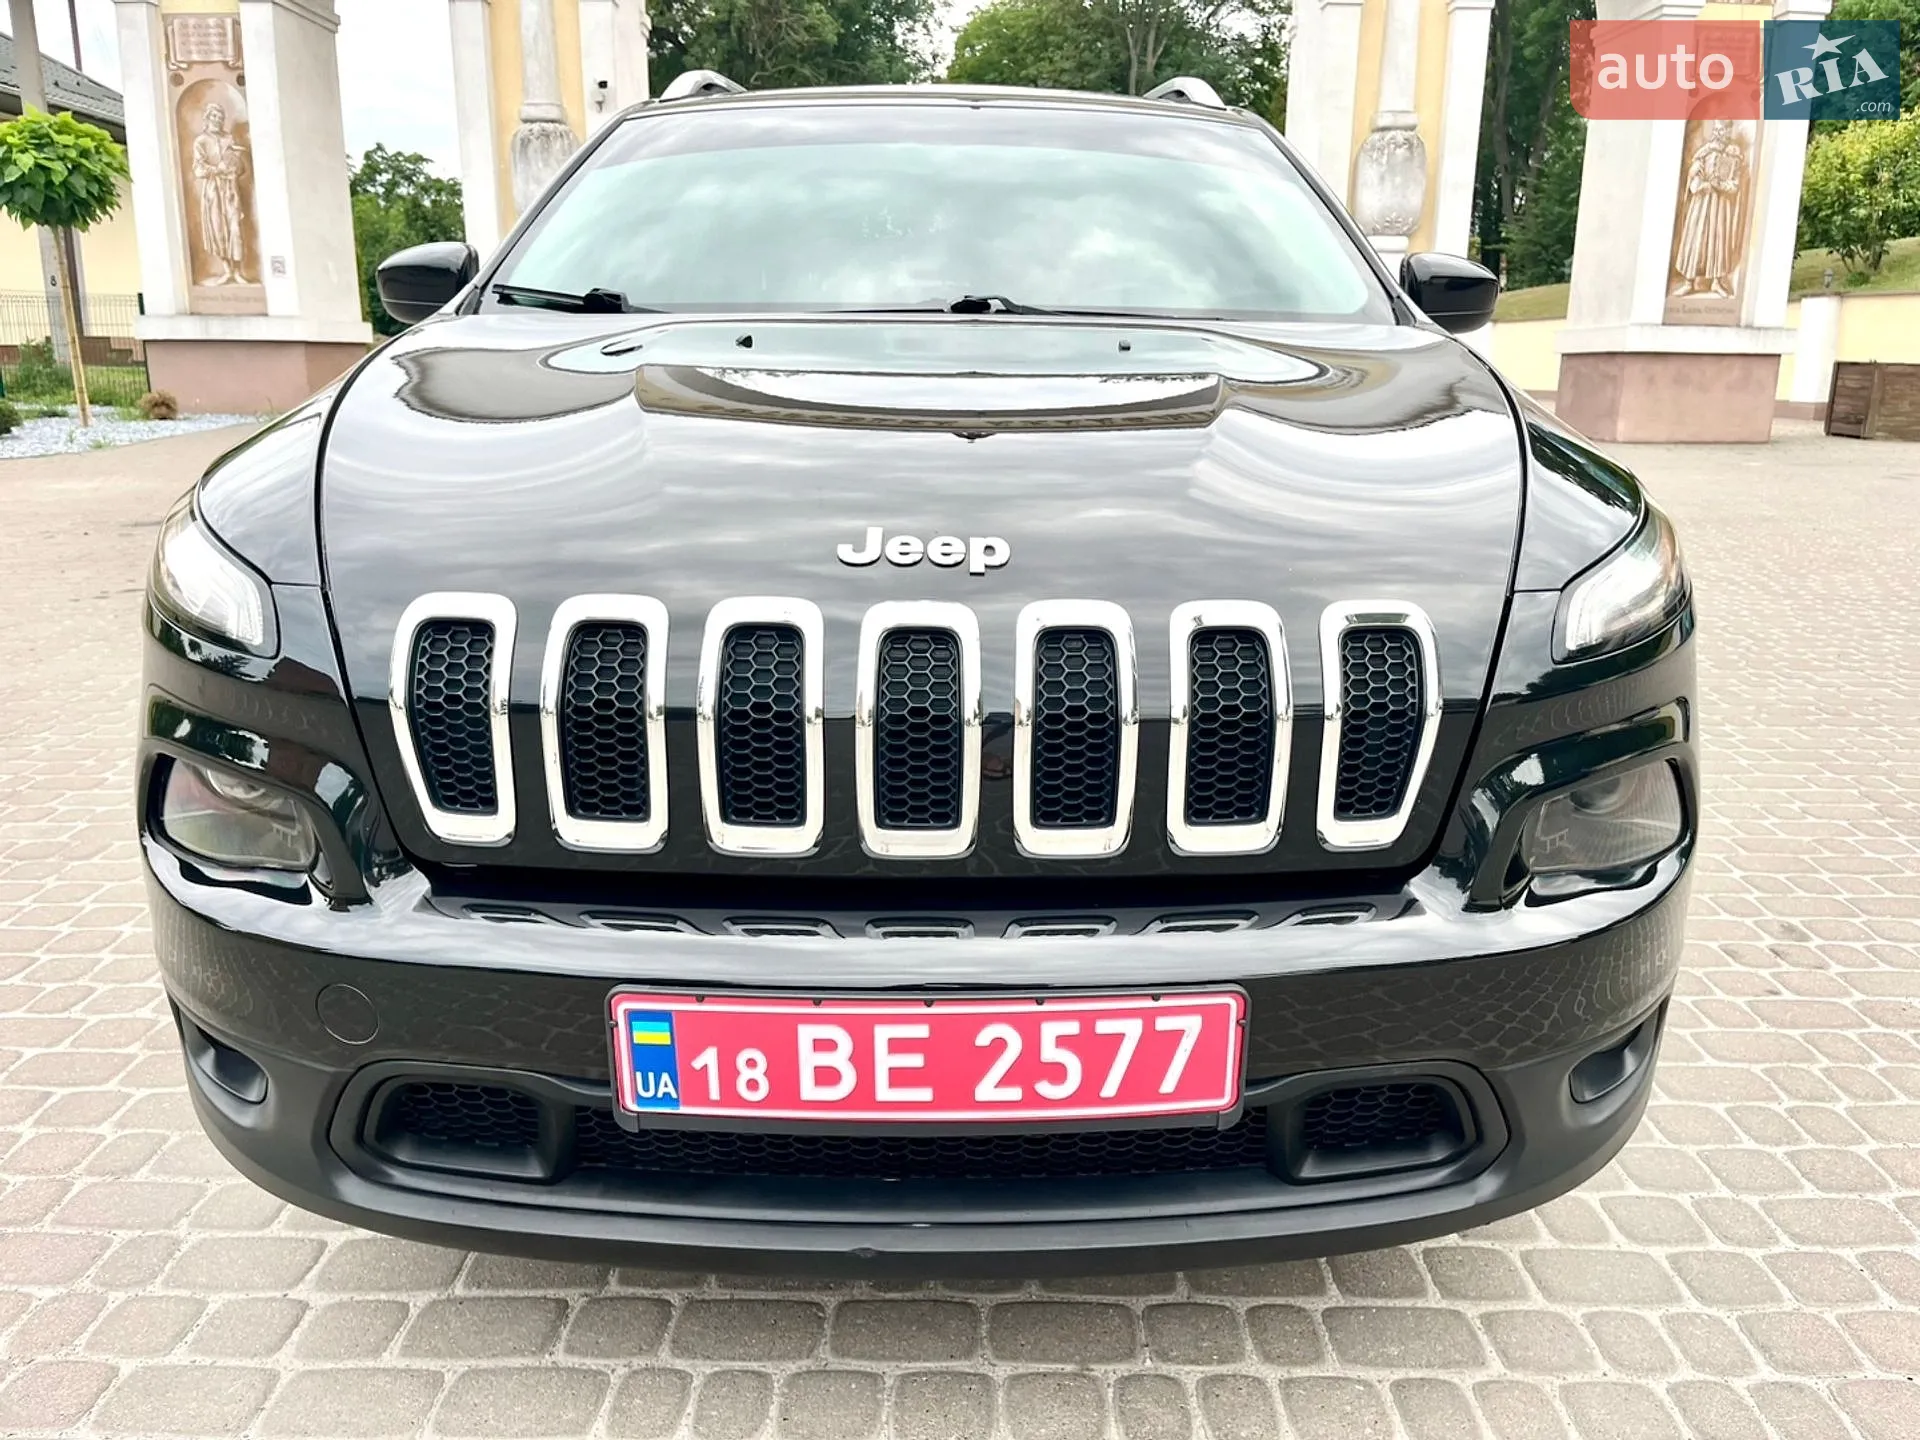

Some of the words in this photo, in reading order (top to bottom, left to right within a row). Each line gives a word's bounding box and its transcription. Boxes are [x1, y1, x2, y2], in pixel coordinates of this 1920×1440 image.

[837, 526, 1011, 576] Jeep
[690, 1046, 770, 1102] 18
[797, 1023, 932, 1103] BE
[974, 1015, 1203, 1103] 2577
[636, 1070, 678, 1100] UA
